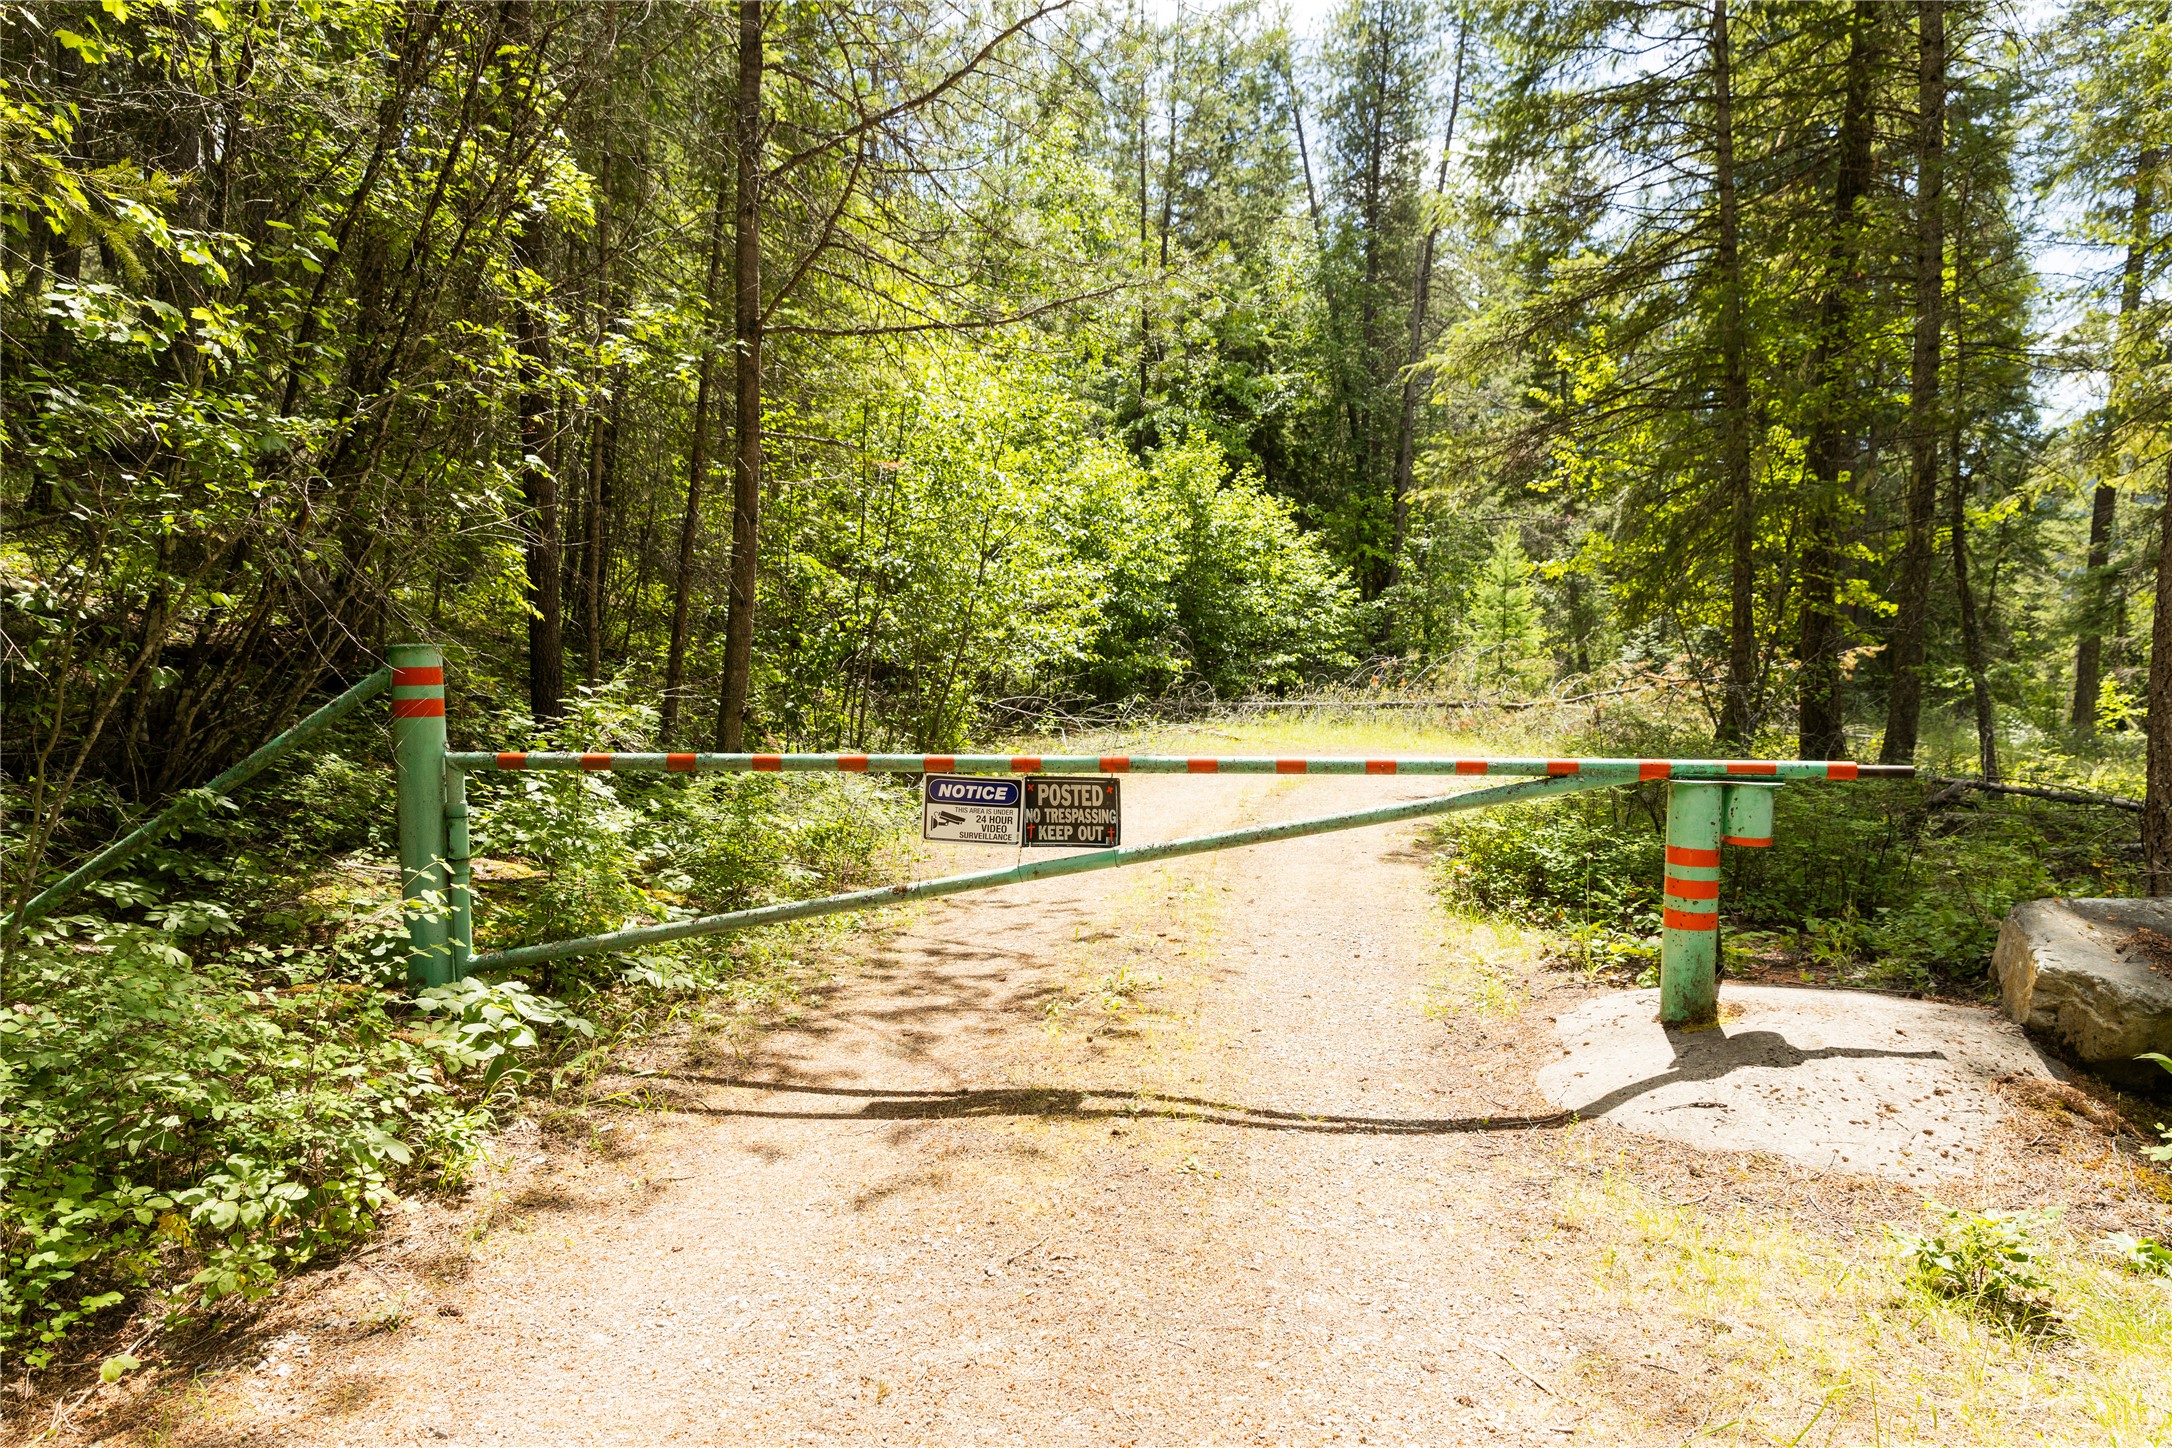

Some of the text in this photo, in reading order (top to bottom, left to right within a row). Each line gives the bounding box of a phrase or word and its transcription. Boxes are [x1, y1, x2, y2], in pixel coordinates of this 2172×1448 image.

[938, 783, 1008, 801] NOTICE
[1037, 783, 1104, 807] POSTED
[976, 815, 1013, 824] 24 HOUR
[1025, 808, 1117, 824] NO TRESPASSING
[959, 831, 1013, 841] SURVEILLANCE
[981, 824, 1008, 833] VIDEO
[1038, 825, 1104, 841] KEEP OUT
